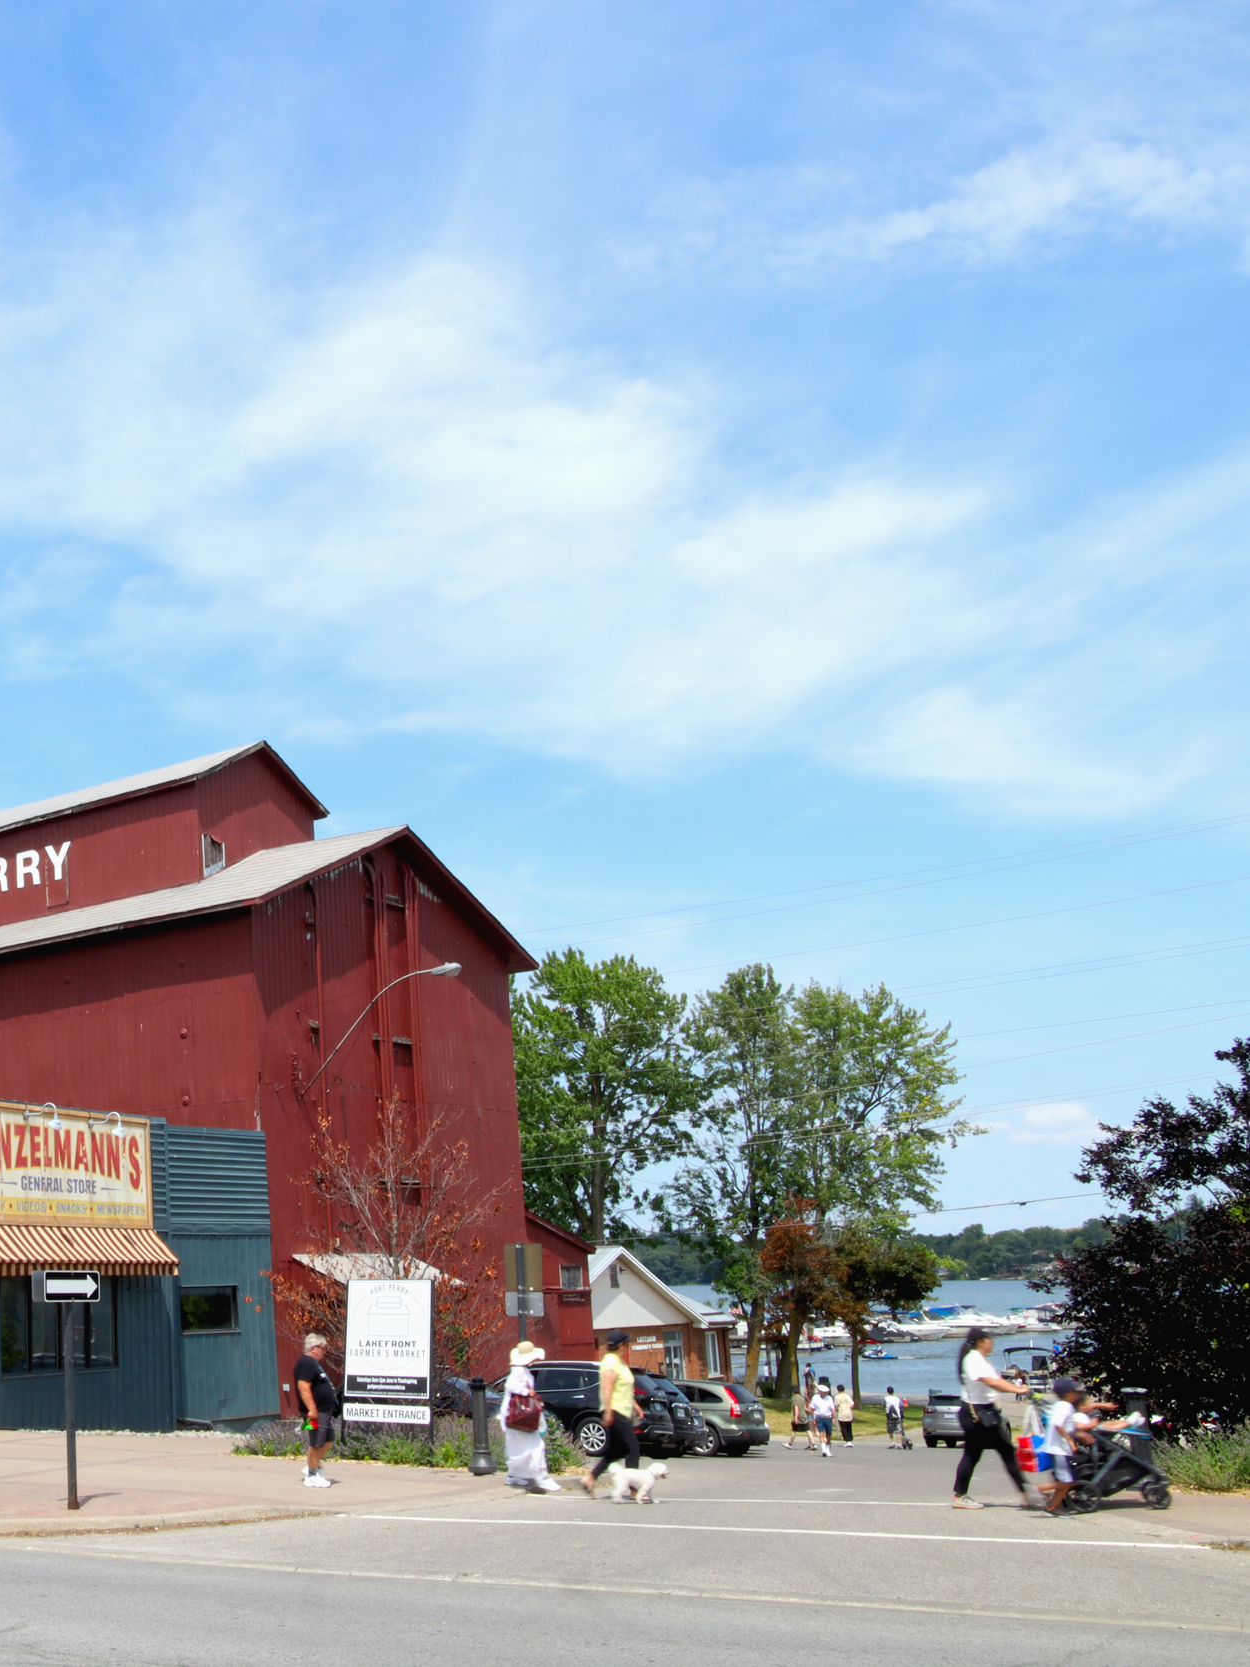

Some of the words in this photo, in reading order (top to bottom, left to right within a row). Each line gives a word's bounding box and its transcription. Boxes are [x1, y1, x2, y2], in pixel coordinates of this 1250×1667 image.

[21, 1175, 64, 1192] GENERAL
[67, 1178, 97, 1194] STORE
[16, 1201, 46, 1213] VIDEOS
[56, 1202, 87, 1214] SNACKS
[96, 1204, 145, 1217] NEWSPAPERS
[370, 1284, 385, 1295] PORT
[389, 1284, 409, 1295] PERRY
[359, 1340, 417, 1348] LAKEFRONT
[350, 1348, 389, 1357] FARMER'S
[393, 1349, 425, 1358] MARKET
[347, 1408, 380, 1418] MARKET
[383, 1409, 427, 1420] ENTRANCE
